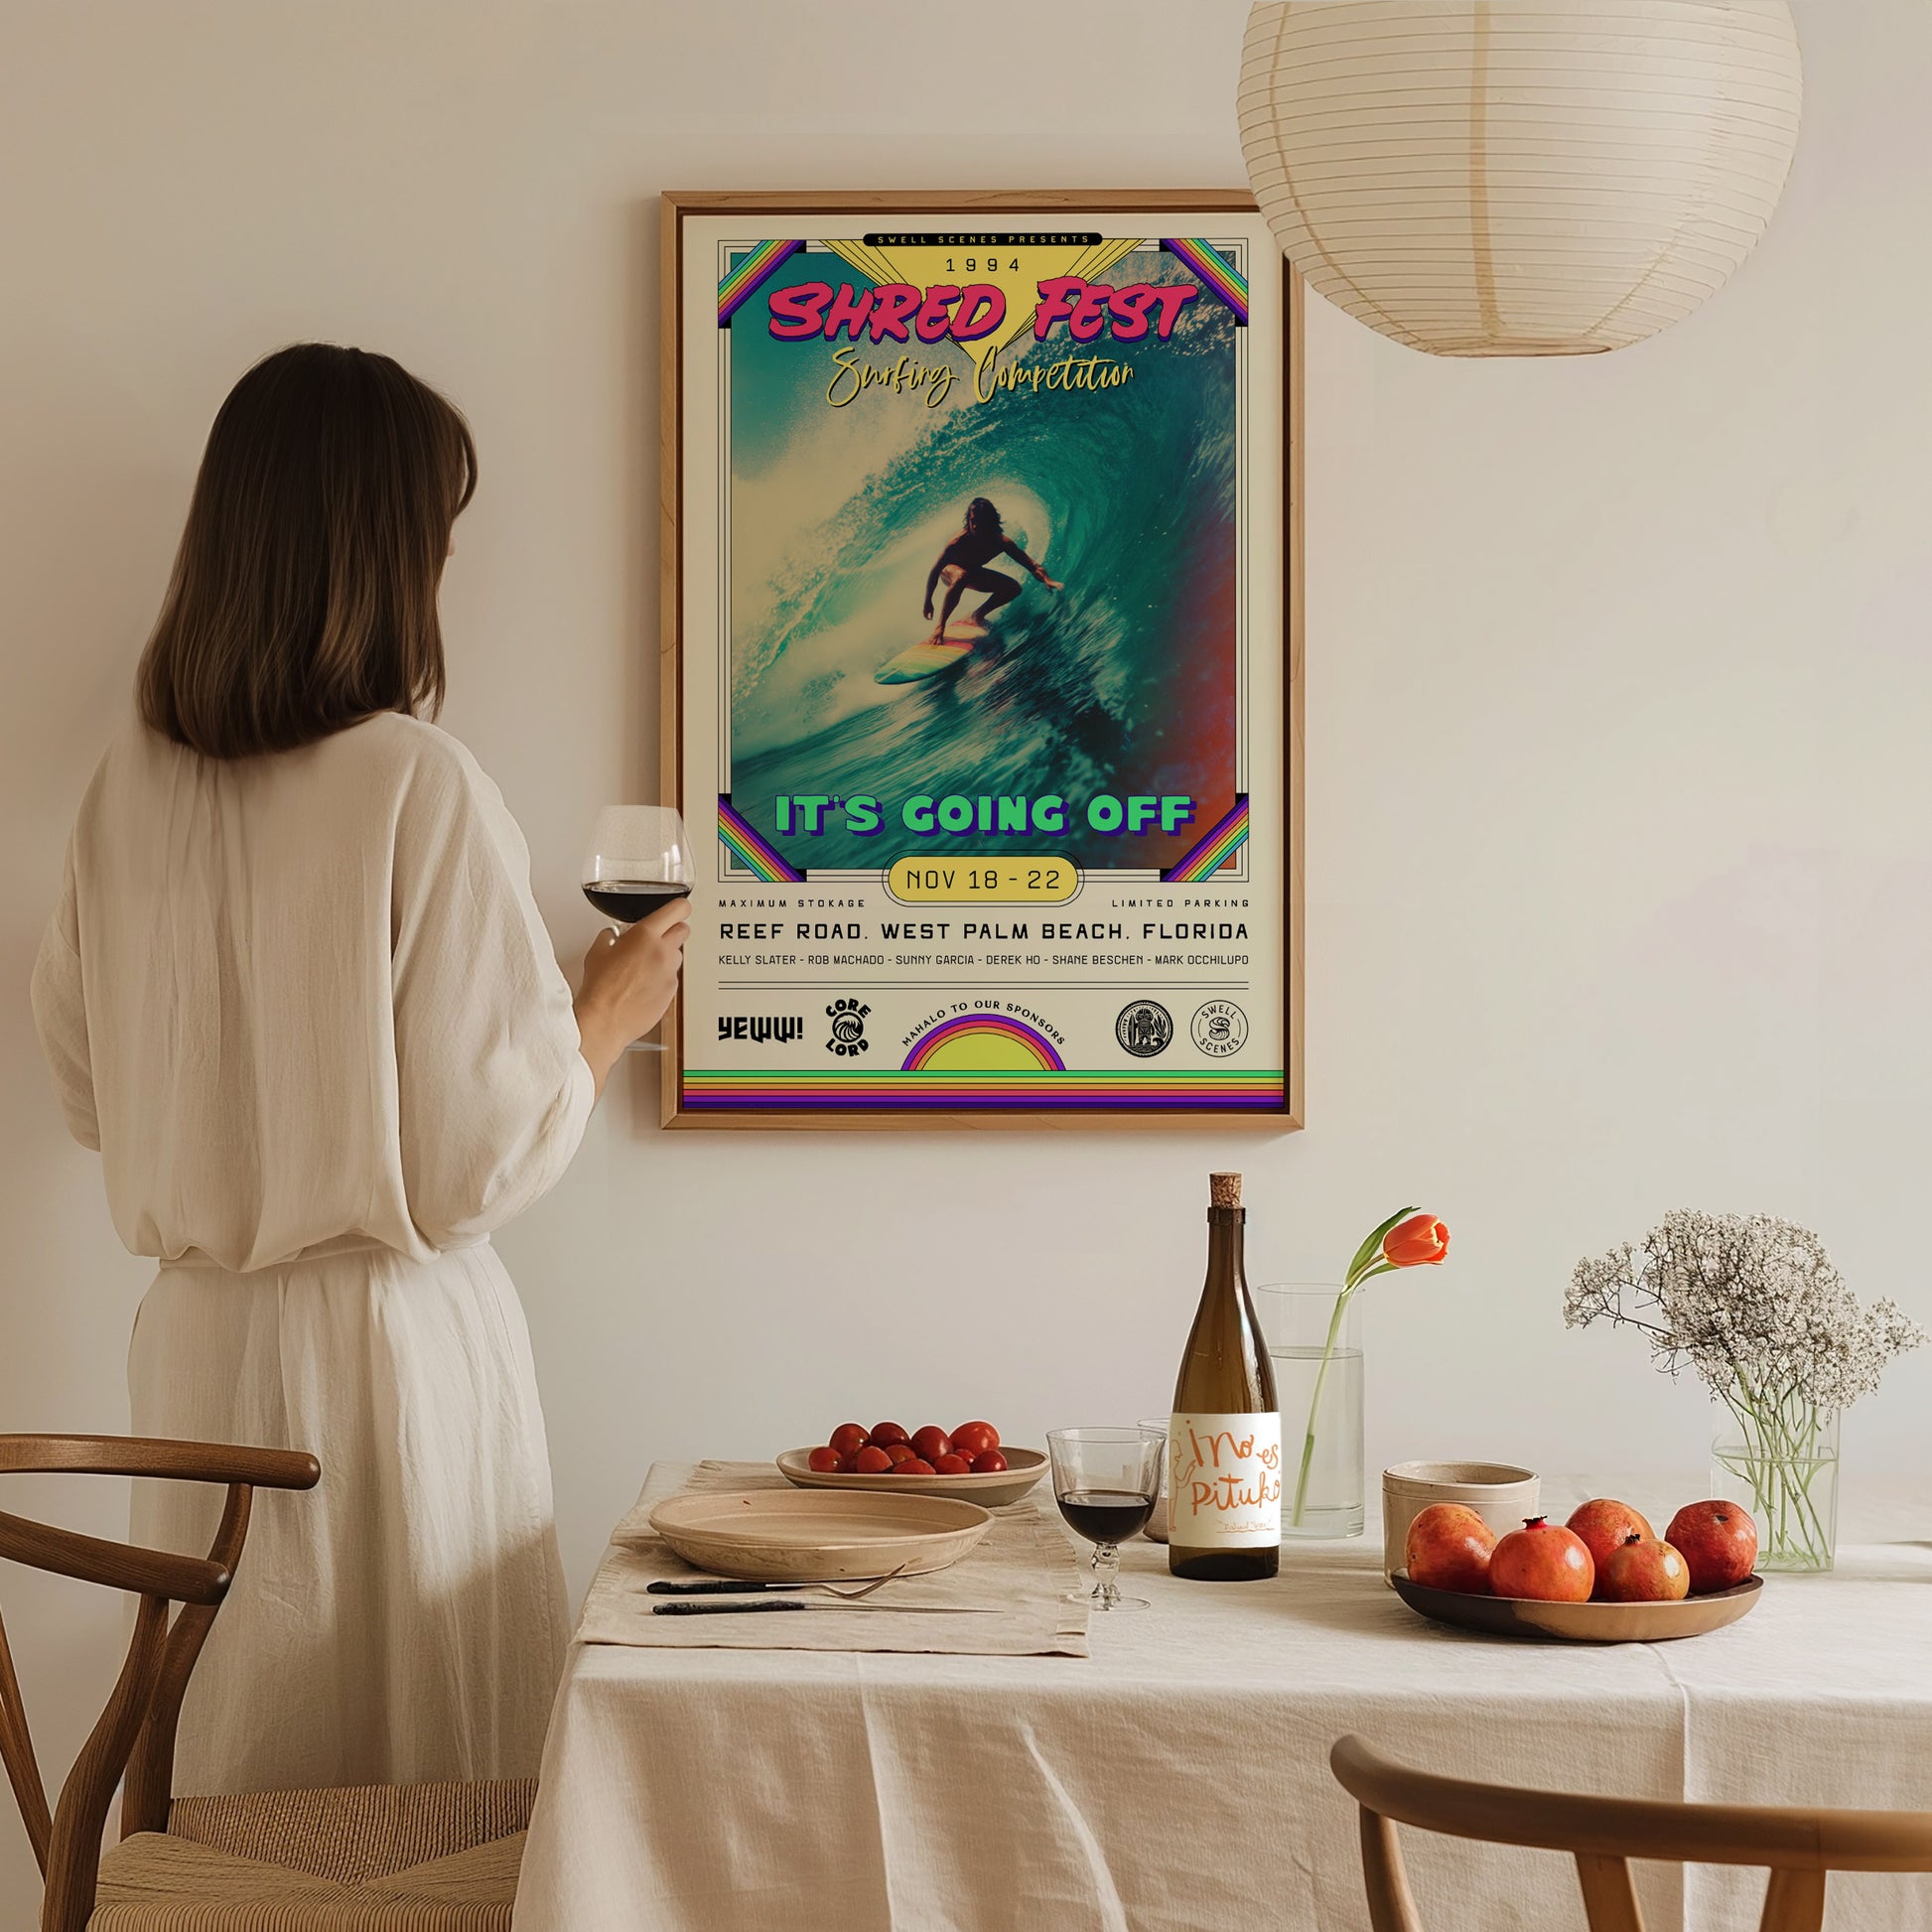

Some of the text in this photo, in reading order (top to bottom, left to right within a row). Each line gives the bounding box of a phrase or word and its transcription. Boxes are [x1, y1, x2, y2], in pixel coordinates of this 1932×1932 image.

[877, 235, 1090, 244] SWELL SCENES PRESENTS
[945, 258, 1020, 272] 1994
[768, 276, 1198, 345] SHRED FEST
[826, 345, 1135, 407] Surfing Competition
[774, 794, 1197, 837] IT'S GOING OFF
[905, 869, 956, 890] NOV
[969, 869, 999, 890] 18
[1027, 869, 1060, 890] 22
[720, 923, 784, 939] REEF
[882, 923, 950, 939] WEST
[963, 923, 1030, 939] PALM
[1143, 923, 1249, 939] FLORIDA
[718, 955, 752, 965] KELLY
[755, 955, 796, 965] SLATER
[808, 955, 830, 965] ROB
[833, 955, 885, 965] MACHADO
[896, 955, 932, 965] SUNNY
[935, 955, 975, 965] GARCIA
[986, 955, 1022, 965] DEREK
[1026, 955, 1040, 965] HO
[1052, 955, 1088, 965] SHANE
[1092, 955, 1144, 965] BESCHEN
[1155, 955, 1184, 965] MARK
[1187, 955, 1249, 965] OCCHILUPO
[825, 998, 872, 1018] CORE
[1201, 1004, 1237, 1020] SWELL
[718, 1017, 803, 1043] YEWW!
[901, 1000, 1065, 1046] MAHALO TO OUR SPONSORS
[825, 1038, 869, 1057] LORD
[1199, 1037, 1240, 1053] SCENES
[1256, 1444, 1279, 1469] es
